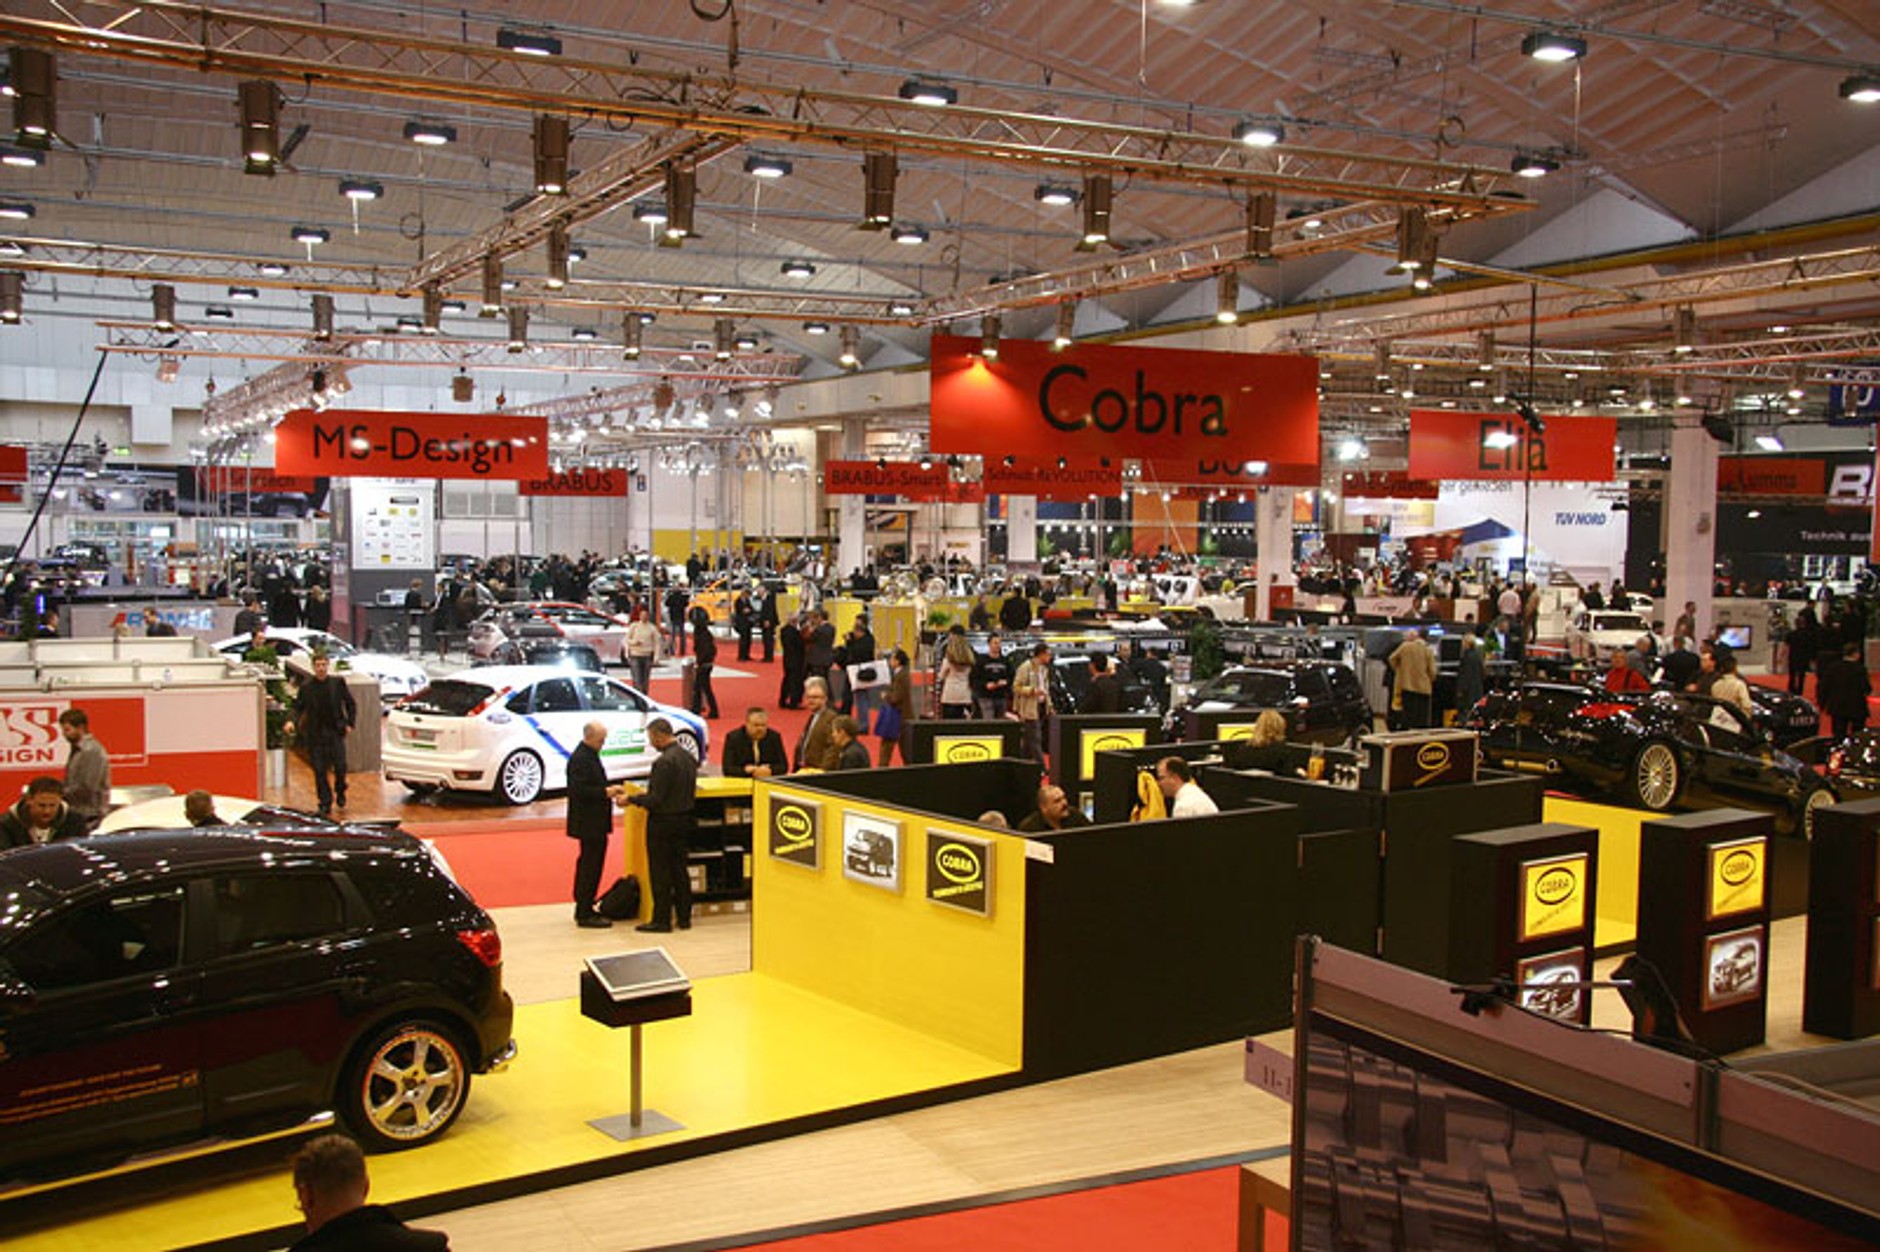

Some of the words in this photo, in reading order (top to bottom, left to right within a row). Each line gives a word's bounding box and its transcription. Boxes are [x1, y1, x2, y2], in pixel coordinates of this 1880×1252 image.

[1040, 363, 1228, 437] Cobra
[313, 424, 513, 474] MS-Design
[1479, 419, 1548, 471] Elia
[1575, 513, 1606, 525] NORD
[1801, 530, 1846, 542] Technik
